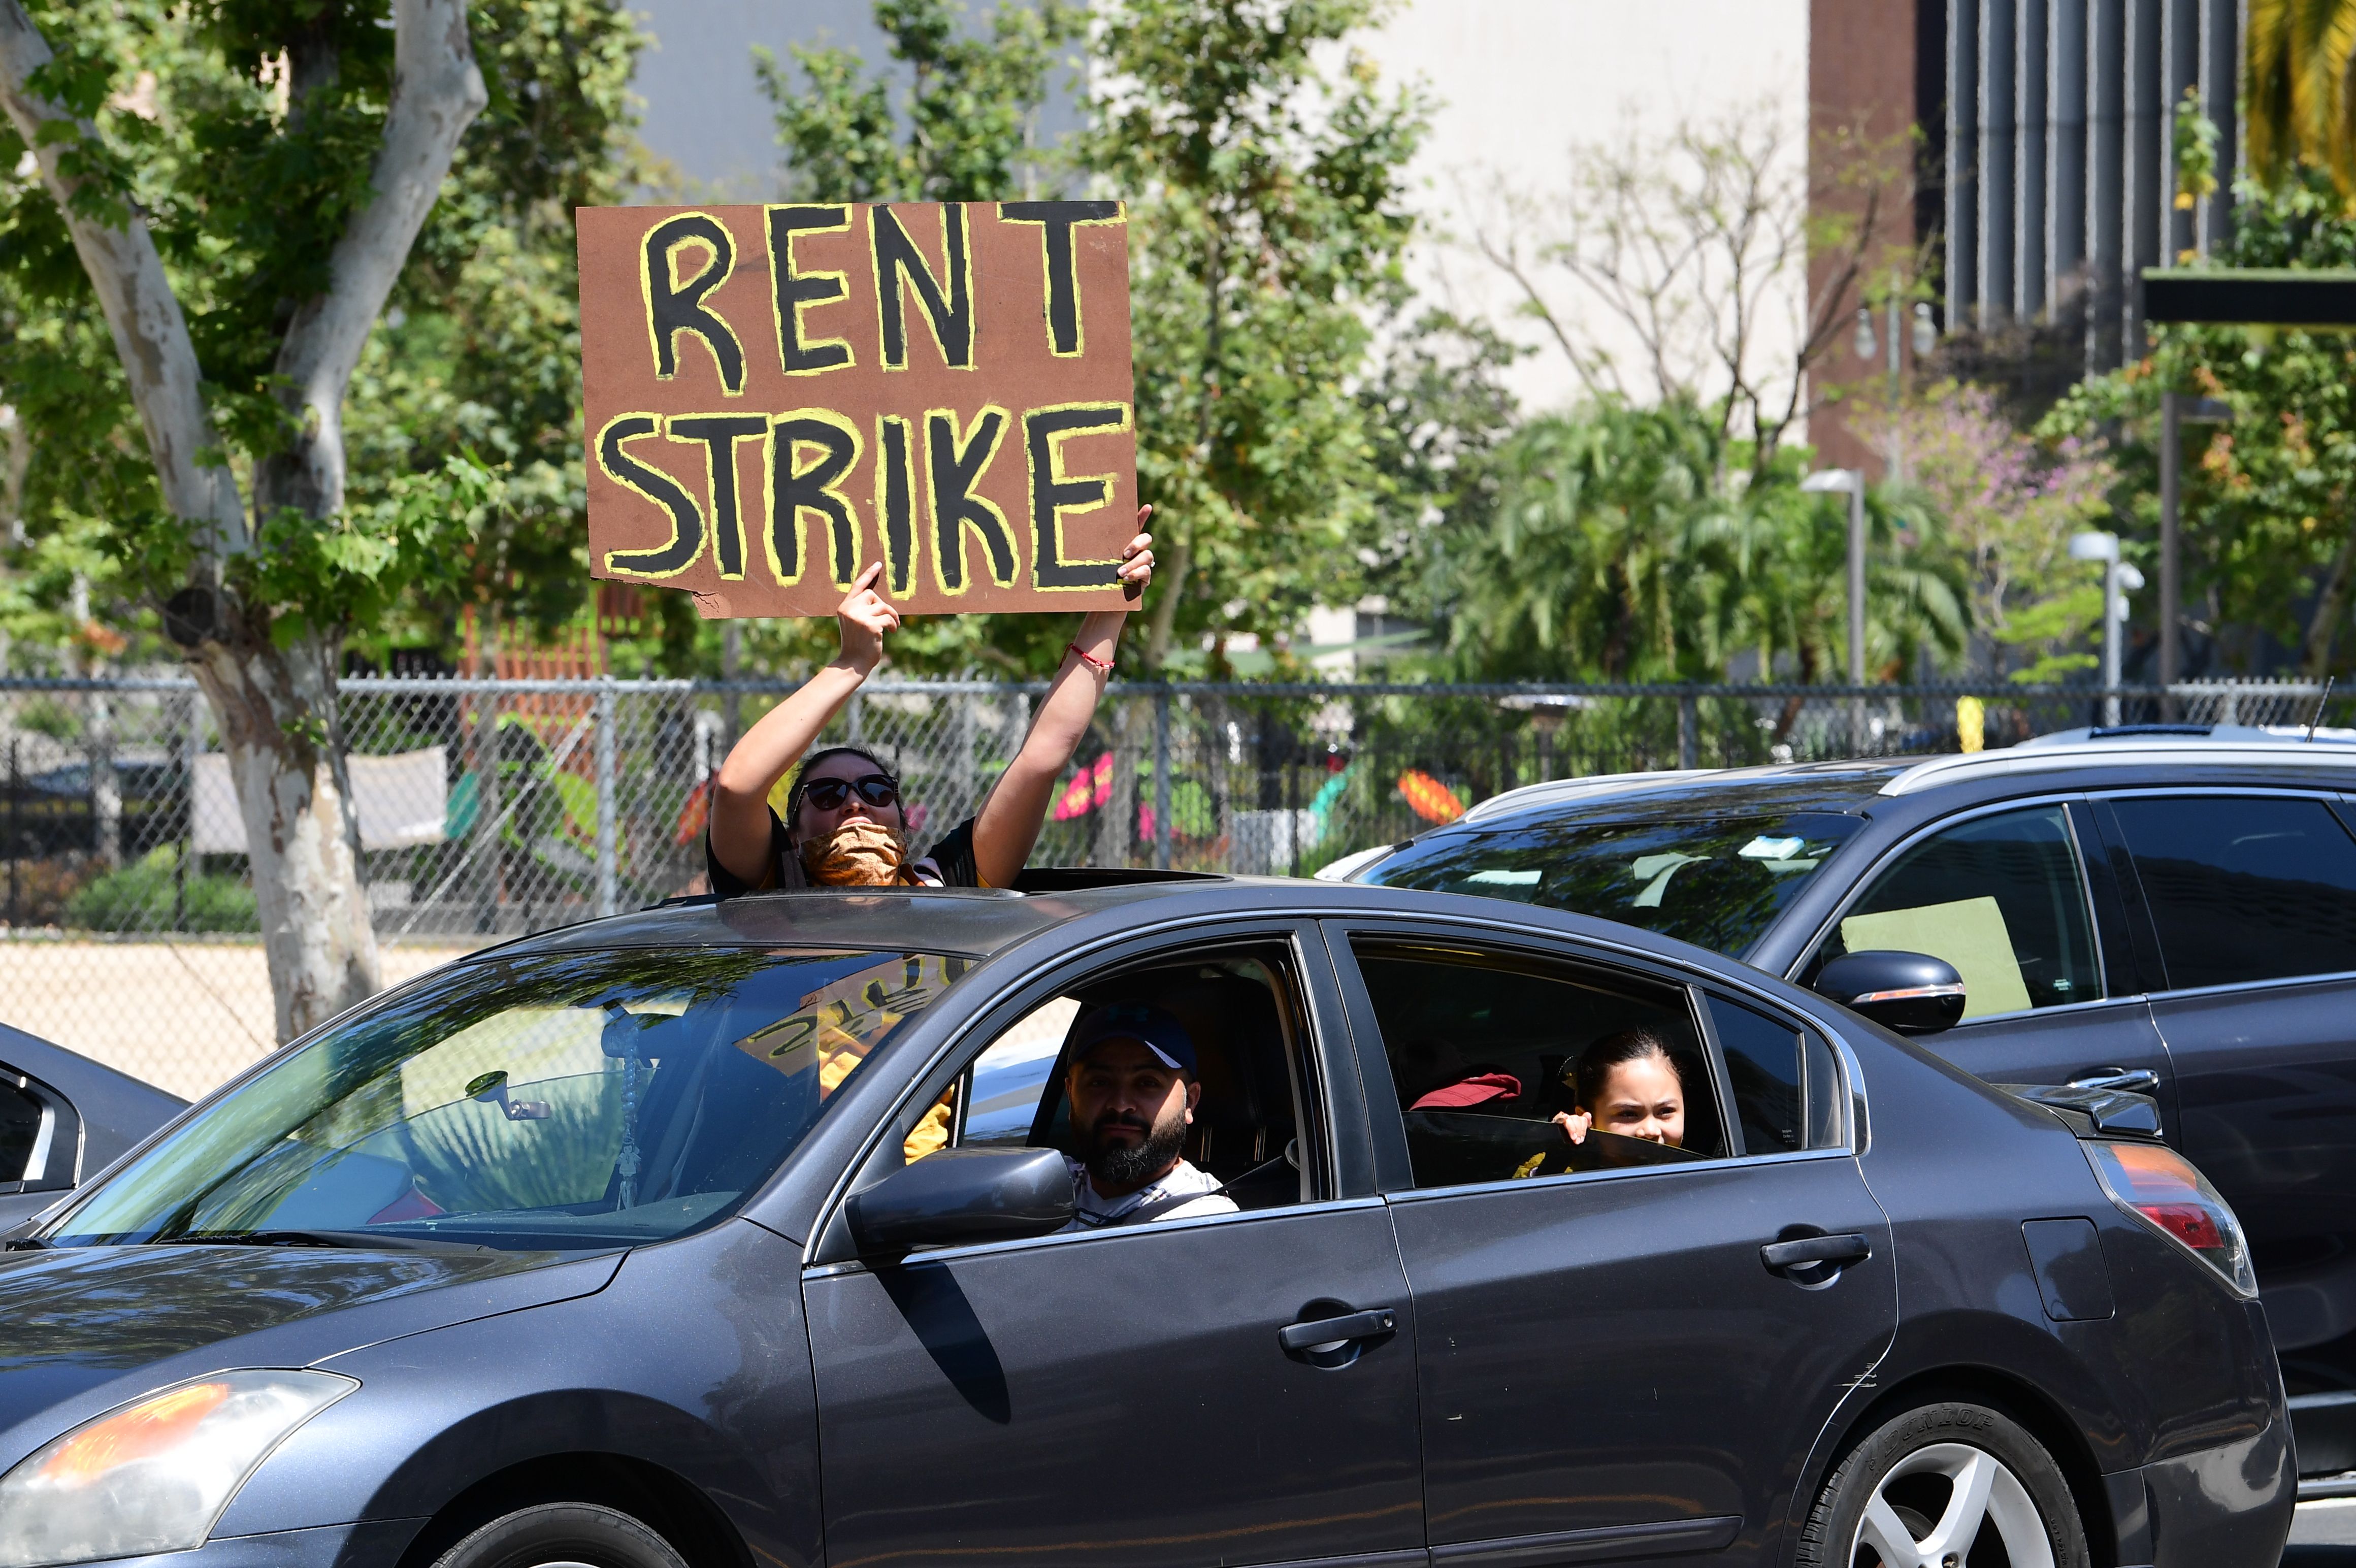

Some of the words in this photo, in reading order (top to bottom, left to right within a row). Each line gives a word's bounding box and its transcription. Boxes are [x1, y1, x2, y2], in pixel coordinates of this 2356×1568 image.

[639, 201, 1127, 396] RENT
[595, 399, 1133, 601] STRIKE
[1884, 1408, 1994, 1458] DUNLOP
